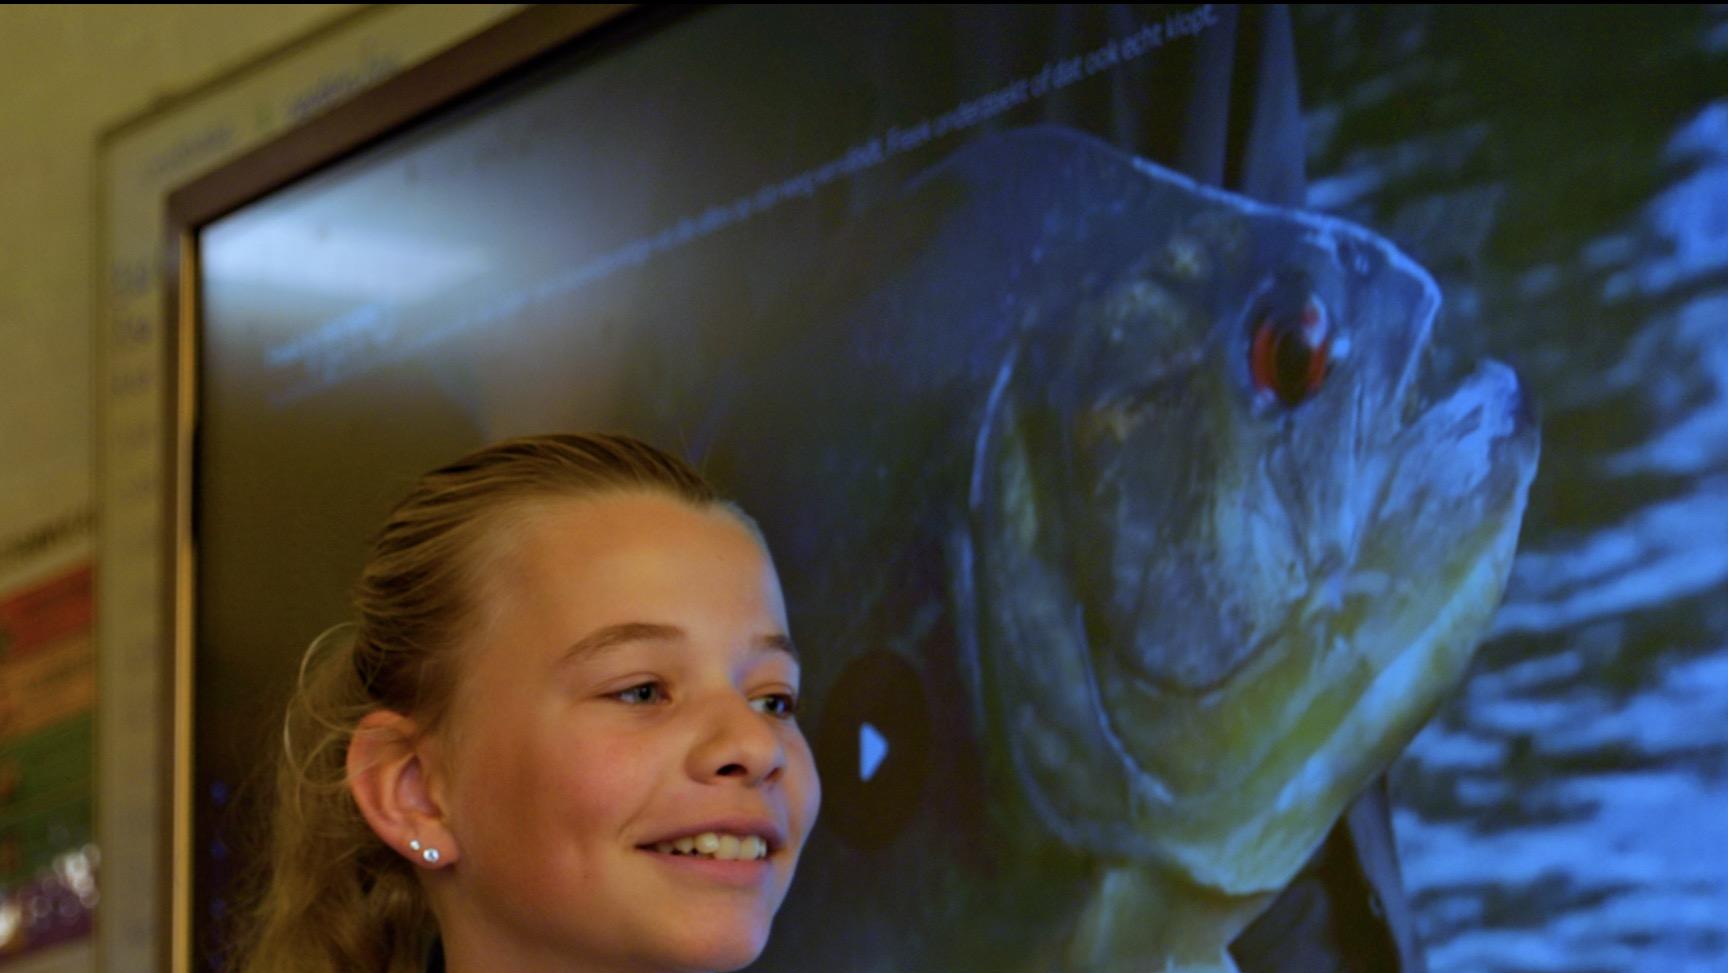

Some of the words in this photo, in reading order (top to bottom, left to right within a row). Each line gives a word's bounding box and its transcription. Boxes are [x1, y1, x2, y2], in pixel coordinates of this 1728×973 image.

[1030, 64, 1051, 98] of
[1085, 38, 1119, 76] ook
[1122, 22, 1163, 61] echt
